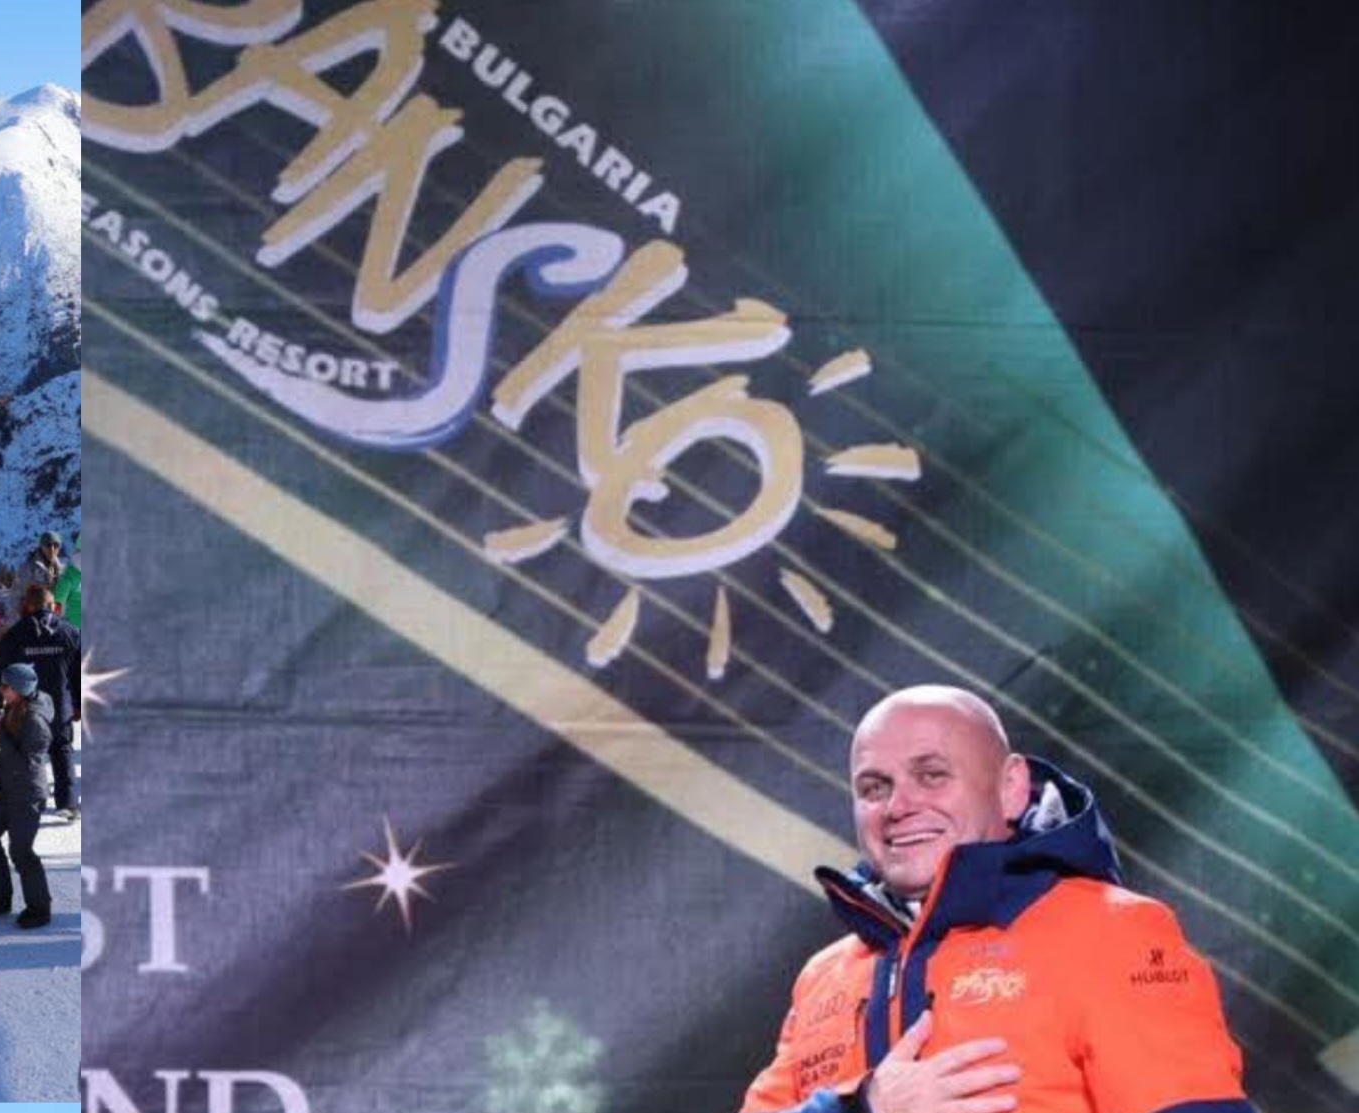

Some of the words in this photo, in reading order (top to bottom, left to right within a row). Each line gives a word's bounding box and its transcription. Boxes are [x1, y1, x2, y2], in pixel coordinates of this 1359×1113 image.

[439, 16, 681, 235] BULGARIA
[81, 0, 803, 579] BANSKO
[227, 316, 400, 390] RESORT
